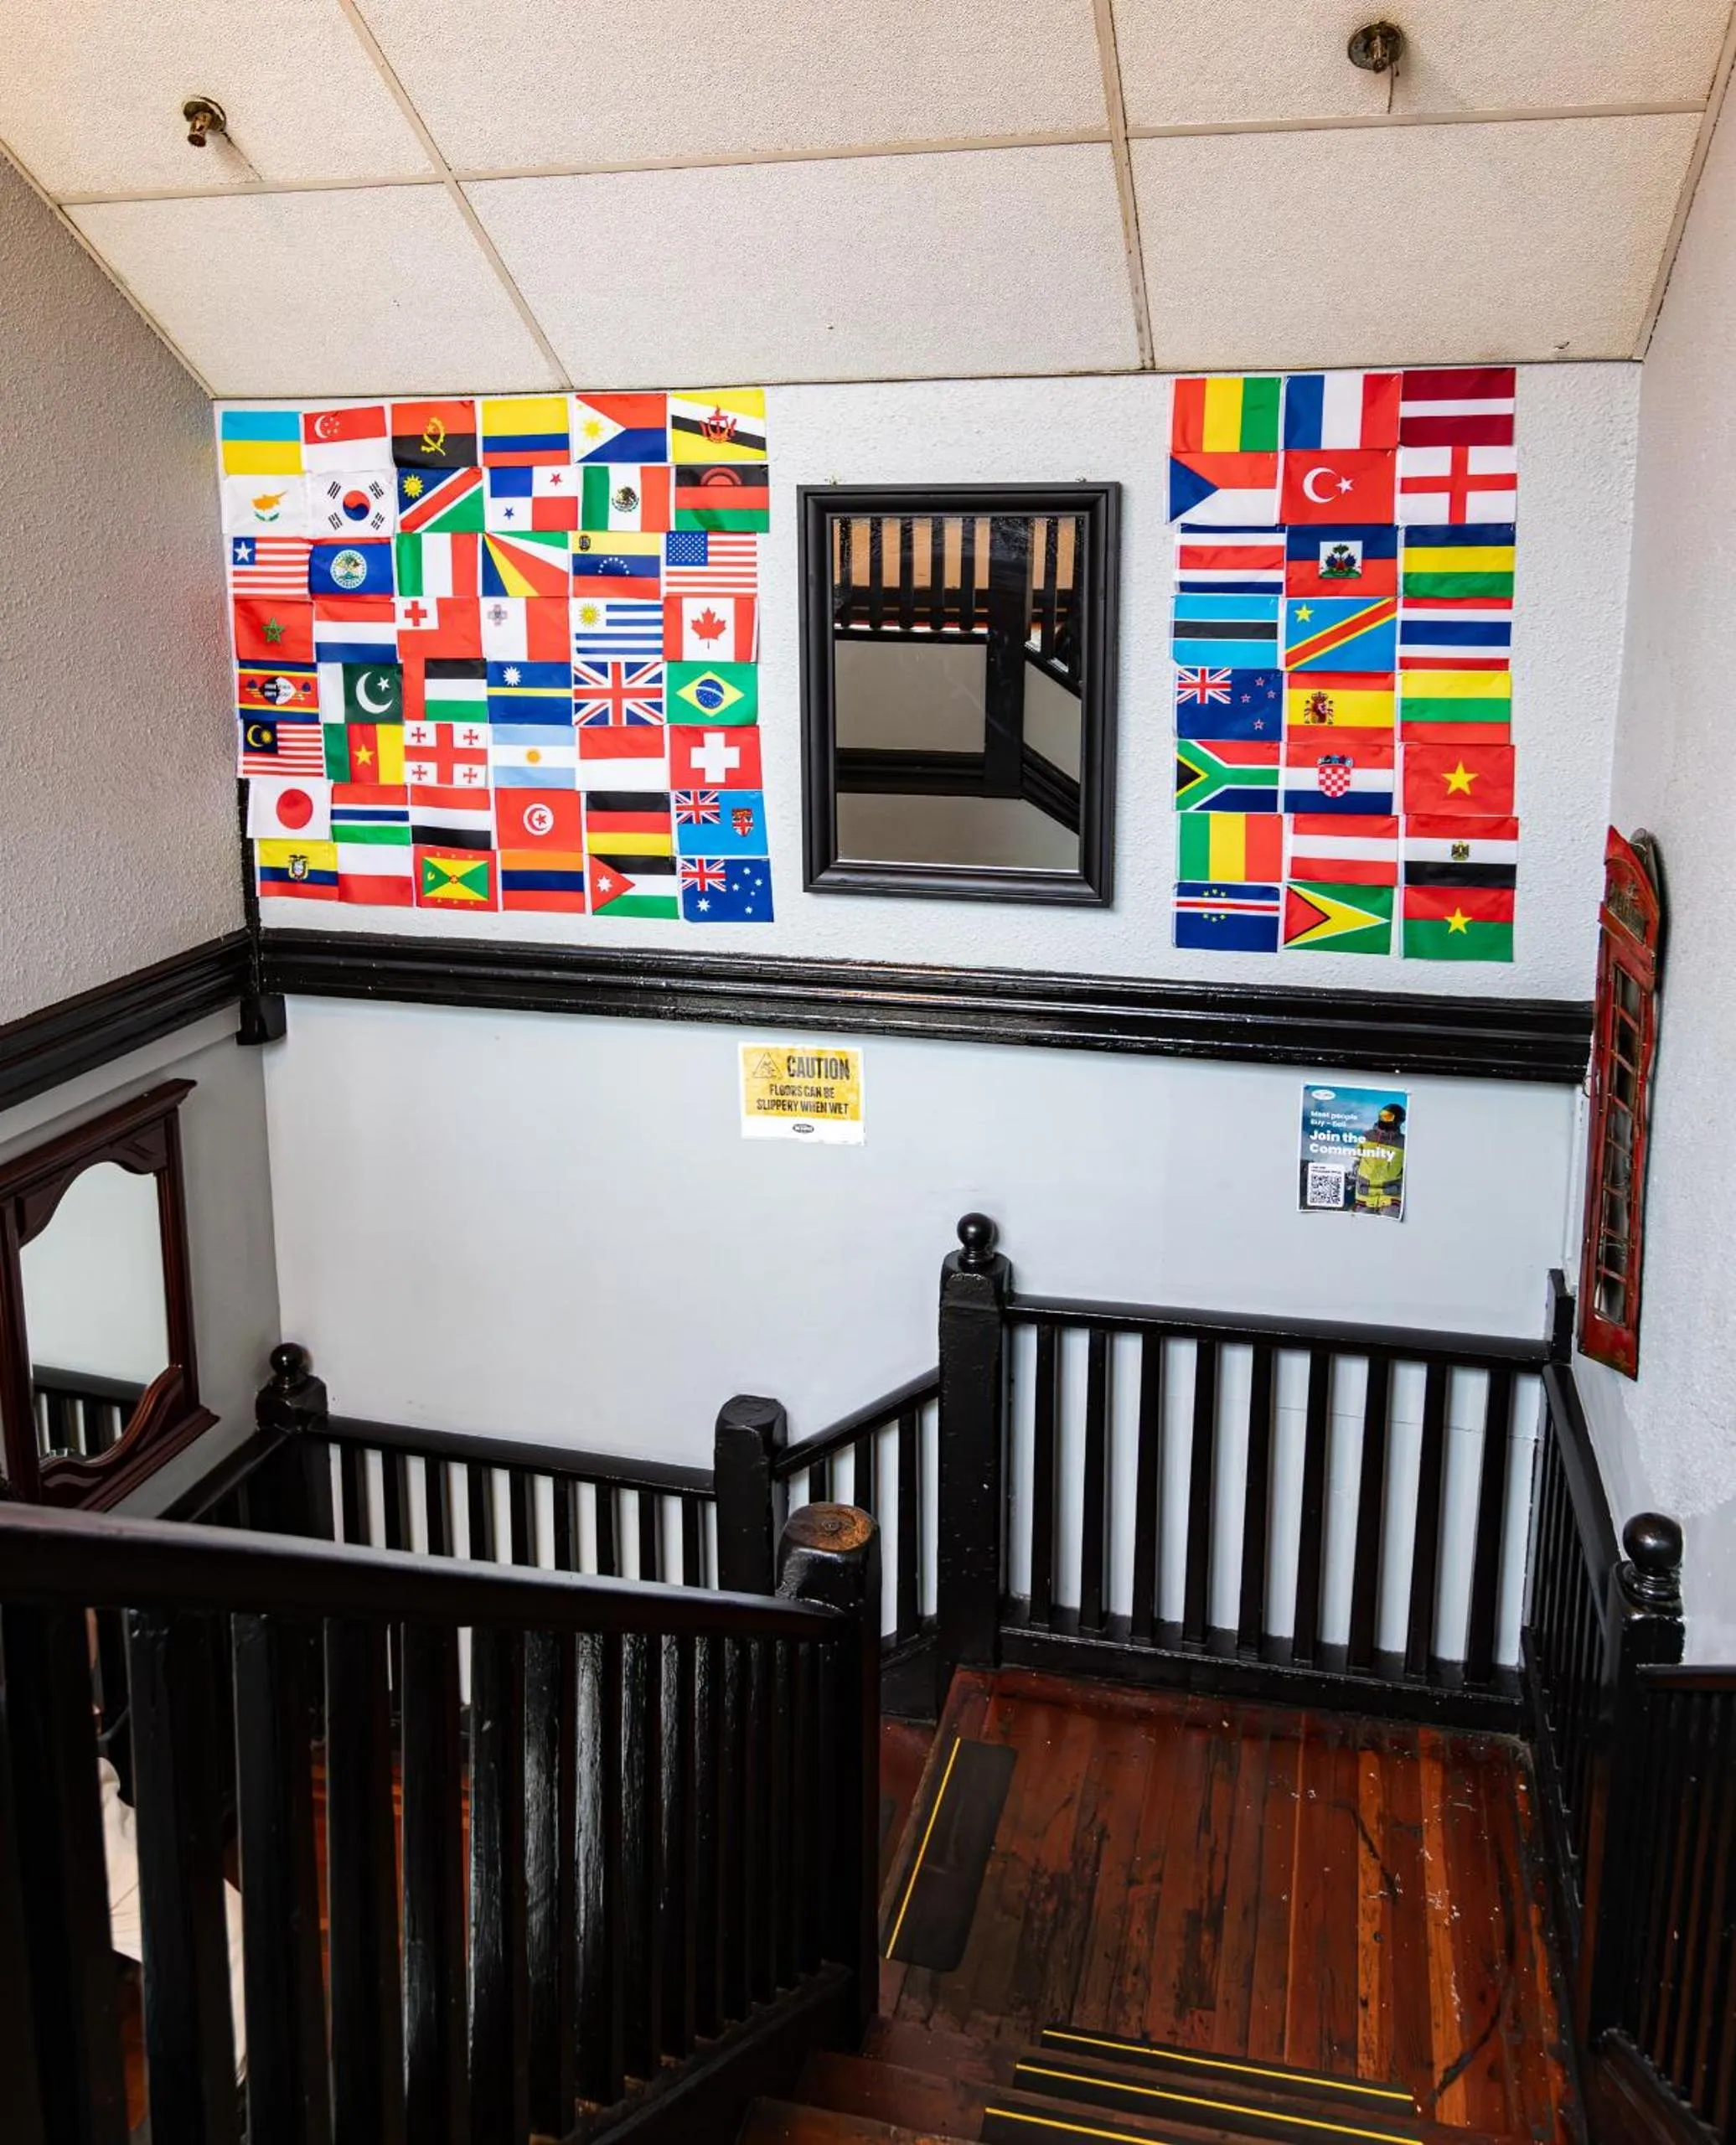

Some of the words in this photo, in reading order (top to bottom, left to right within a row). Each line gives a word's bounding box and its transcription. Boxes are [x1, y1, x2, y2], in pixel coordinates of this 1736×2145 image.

[787, 1055, 850, 1080] CAUTION
[769, 1083, 803, 1096] FLOORS
[803, 1086, 822, 1098] CAN
[824, 1087, 835, 1098] BE
[757, 1098, 798, 1111] SLIPPERY
[800, 1099, 827, 1113] WHEN
[829, 1102, 850, 1114] WET
[1310, 1130, 1341, 1142] Join
[1342, 1132, 1367, 1143] the
[1309, 1143, 1395, 1161] Community
